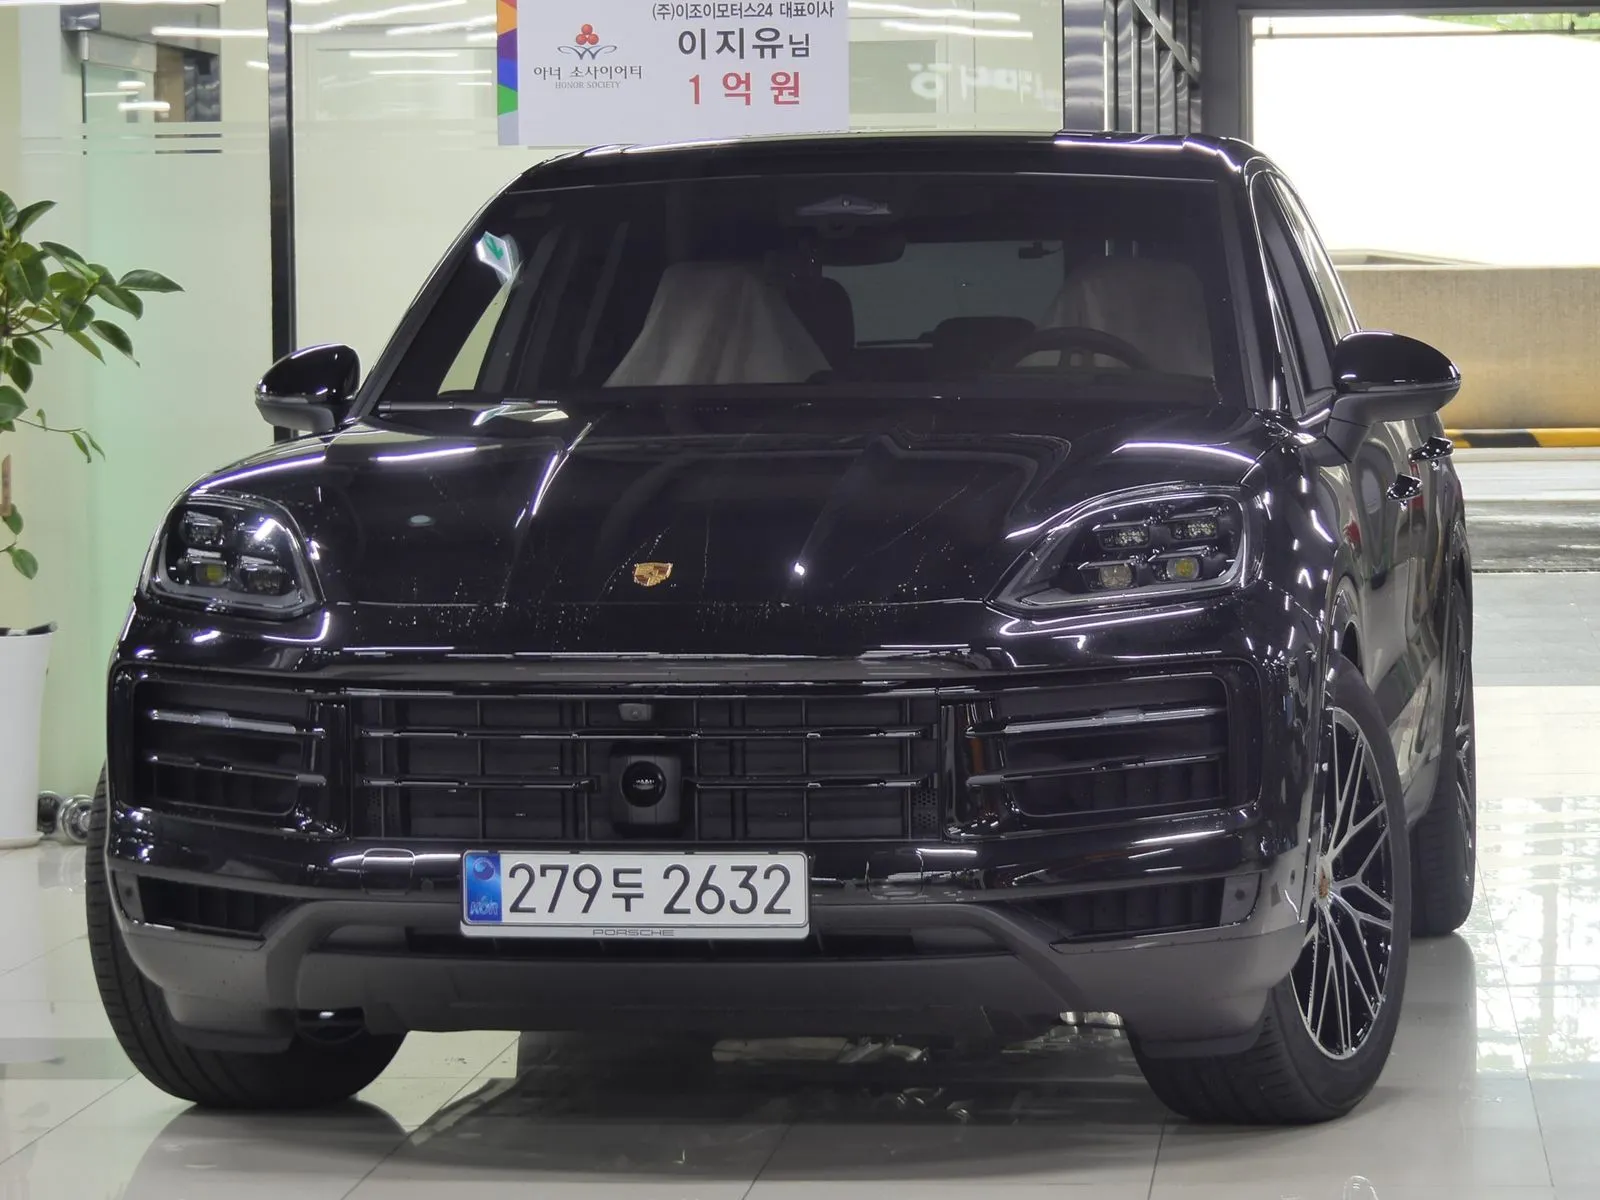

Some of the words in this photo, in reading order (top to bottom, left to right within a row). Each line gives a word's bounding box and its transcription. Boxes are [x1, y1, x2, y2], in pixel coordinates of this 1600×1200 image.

[652, 2, 773, 20] (주)이조이모터스24
[779, 1, 834, 18] 대표이사
[678, 27, 810, 60] 이지유님
[570, 65, 642, 80] 소사이어티
[555, 81, 584, 89] HONOR
[586, 81, 621, 89] SOCIETY
[508, 863, 644, 914] 279두
[662, 864, 792, 915] 2632
